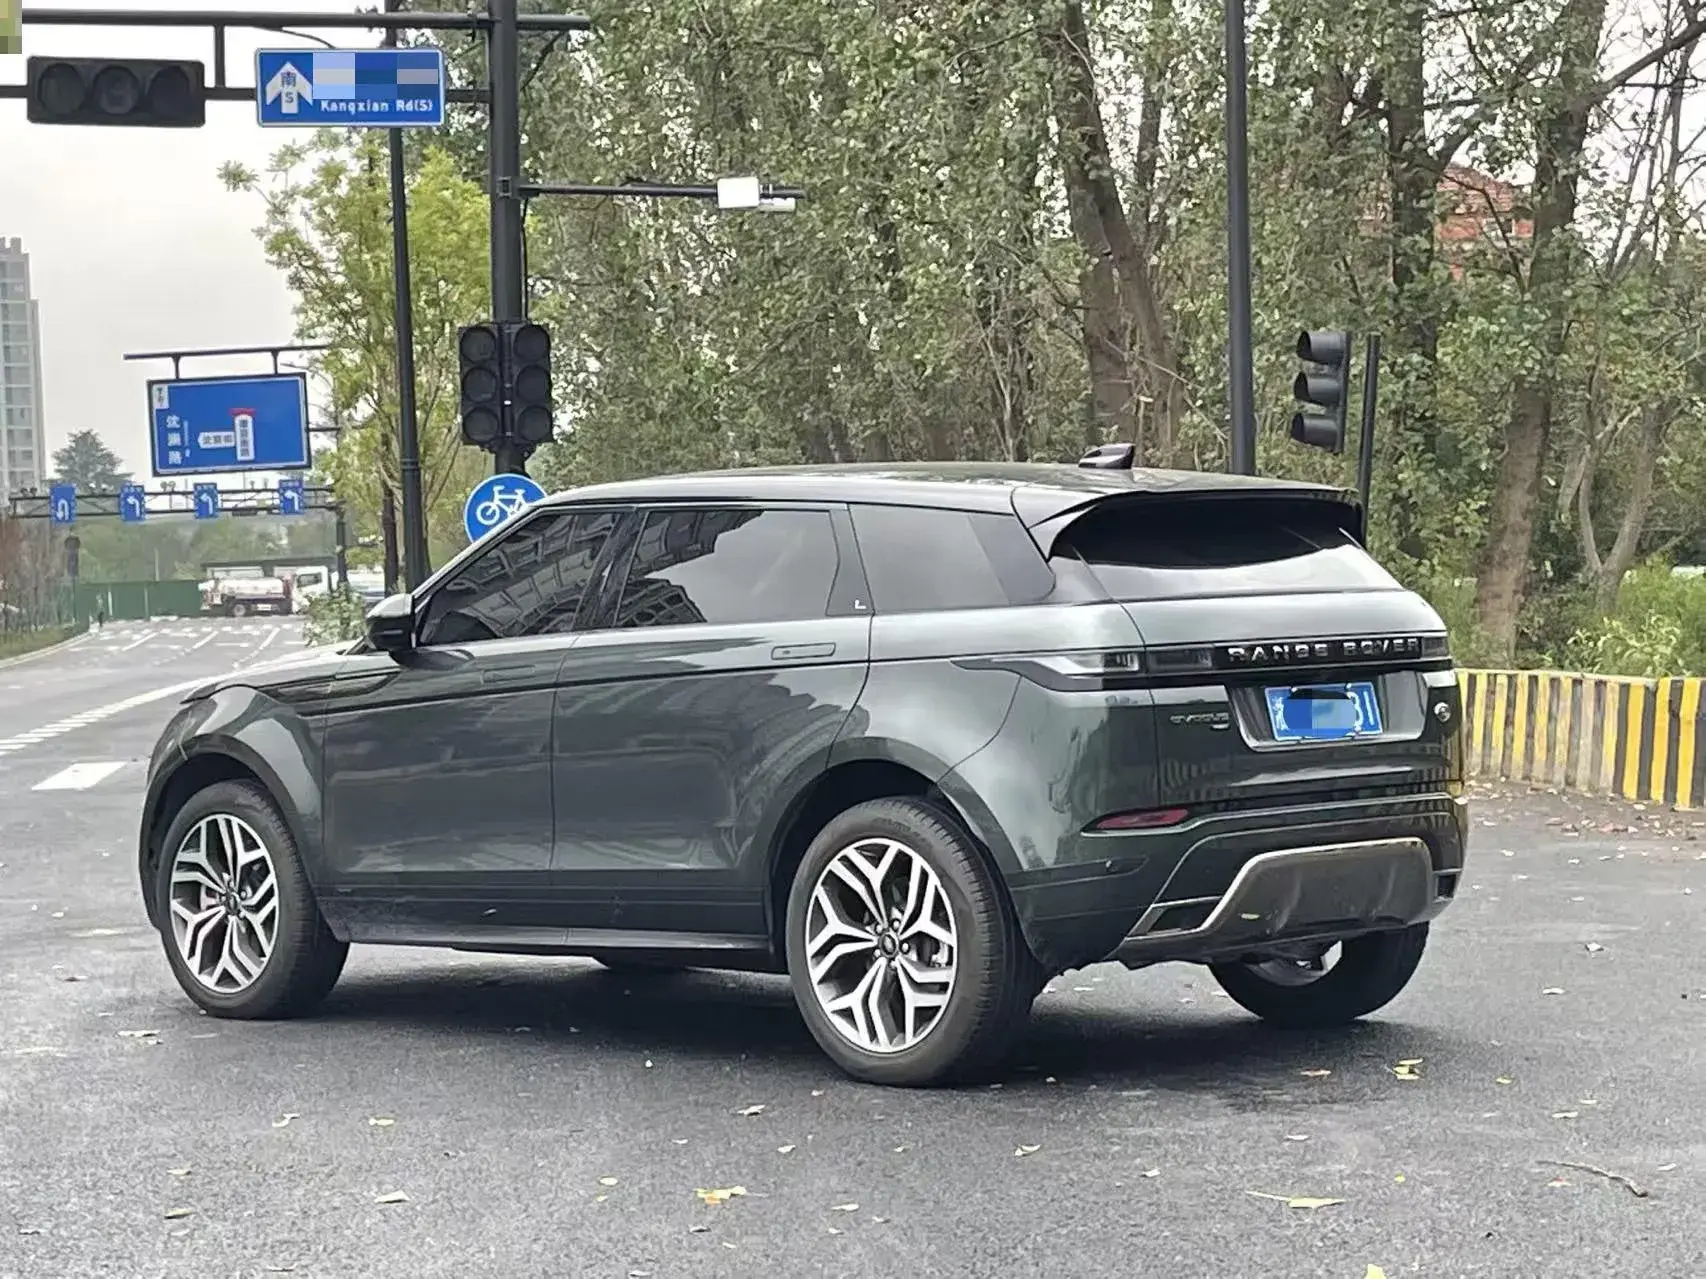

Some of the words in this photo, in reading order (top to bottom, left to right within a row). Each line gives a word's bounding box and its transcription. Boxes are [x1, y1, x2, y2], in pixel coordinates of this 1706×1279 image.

[280, 71, 297, 88] 南
[284, 91, 294, 104] S
[320, 99, 389, 115] Kangxian
[395, 98, 433, 113] Rd(S)
[1227, 643, 1329, 663] RANGE
[1342, 637, 1420, 657] ROVER
